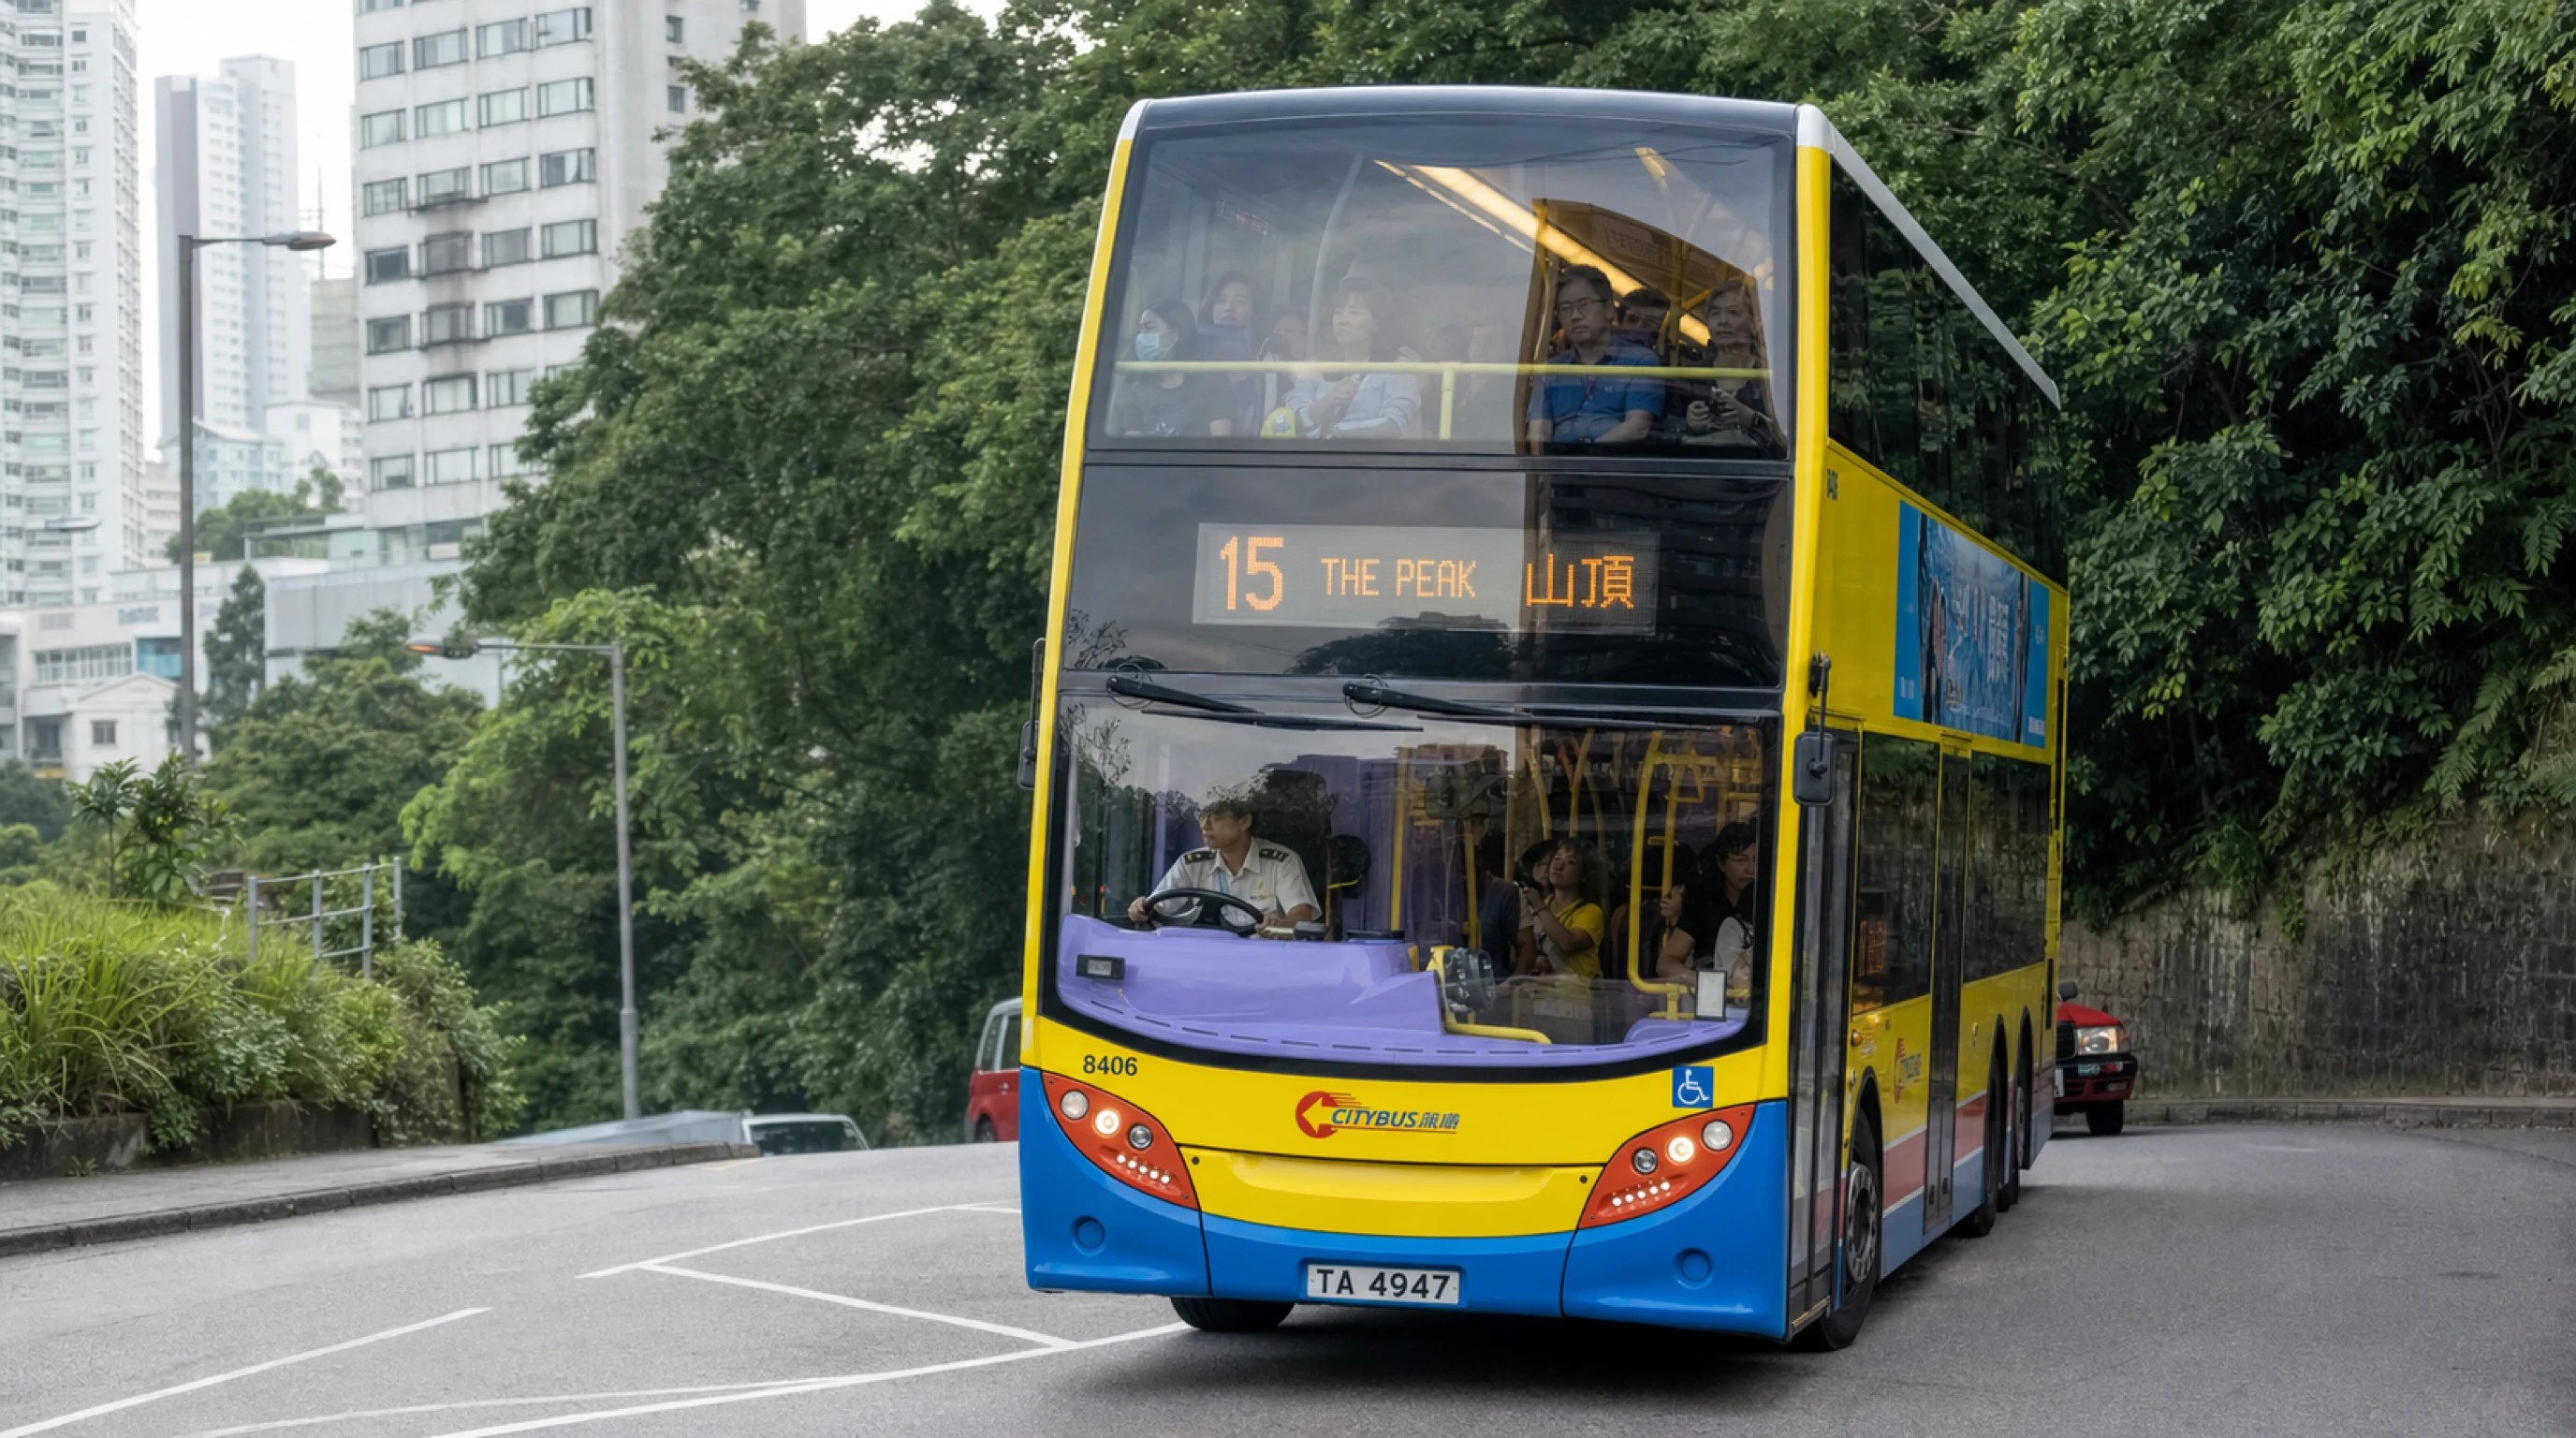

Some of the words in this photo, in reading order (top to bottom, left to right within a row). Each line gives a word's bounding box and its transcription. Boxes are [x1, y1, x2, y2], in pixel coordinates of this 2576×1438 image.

[1220, 536, 1284, 610] 15
[1321, 558, 1380, 596] THE
[1395, 559, 1476, 598] PEAK
[1526, 553, 1634, 609] 山頂
[1083, 1054, 1138, 1077] 8406
[1331, 1108, 1419, 1128] CITYBUS
[1316, 1269, 1354, 1295] TA
[1368, 1271, 1451, 1299] 4947
